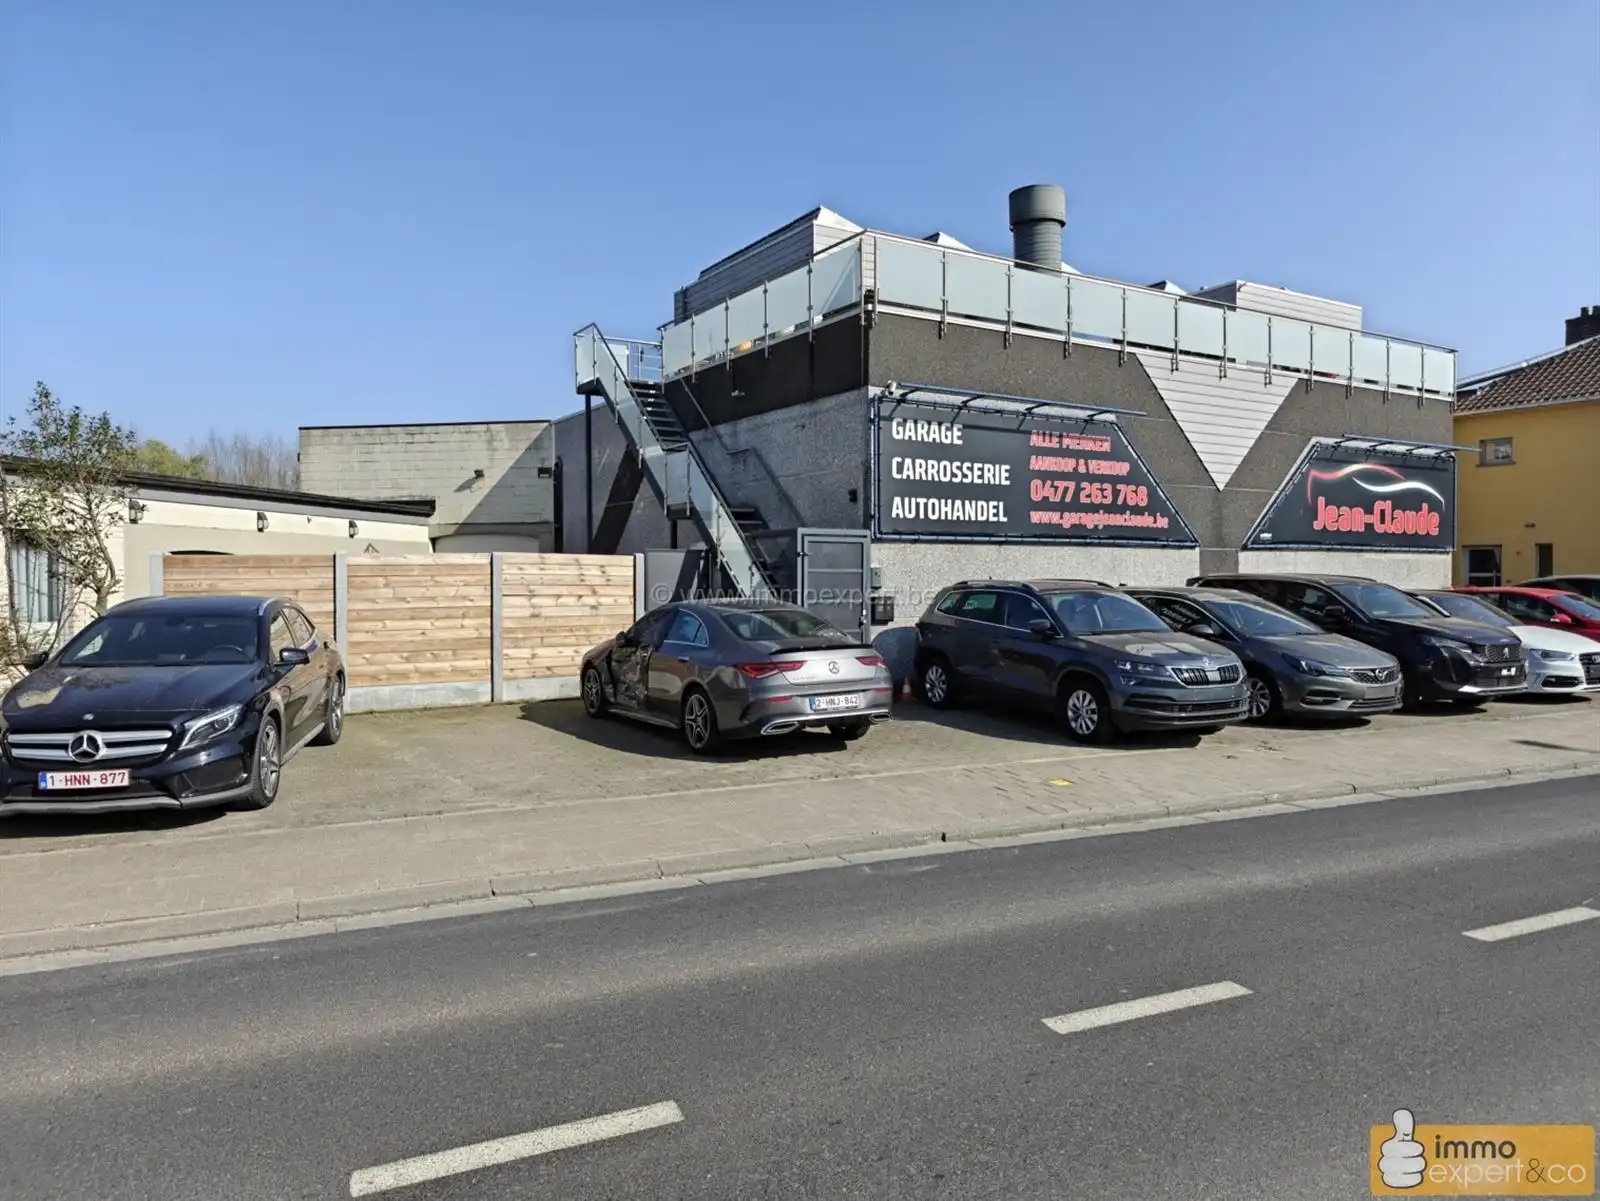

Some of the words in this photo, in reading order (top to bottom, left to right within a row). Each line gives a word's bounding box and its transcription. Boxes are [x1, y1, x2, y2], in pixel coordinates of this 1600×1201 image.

[891, 417, 963, 445] GARAGE
[1030, 430, 1060, 448] ALLE
[891, 456, 1011, 486] CARROSSERIE
[1078, 458, 1087, 474] &
[1030, 479, 1076, 502] 0477
[1079, 481, 1113, 504] 263
[1116, 484, 1148, 506] 768
[891, 496, 1008, 523] AUTOHANDEL
[1313, 496, 1440, 536] Jean-Claude
[49, 772, 126, 787] 1-HNN-877
